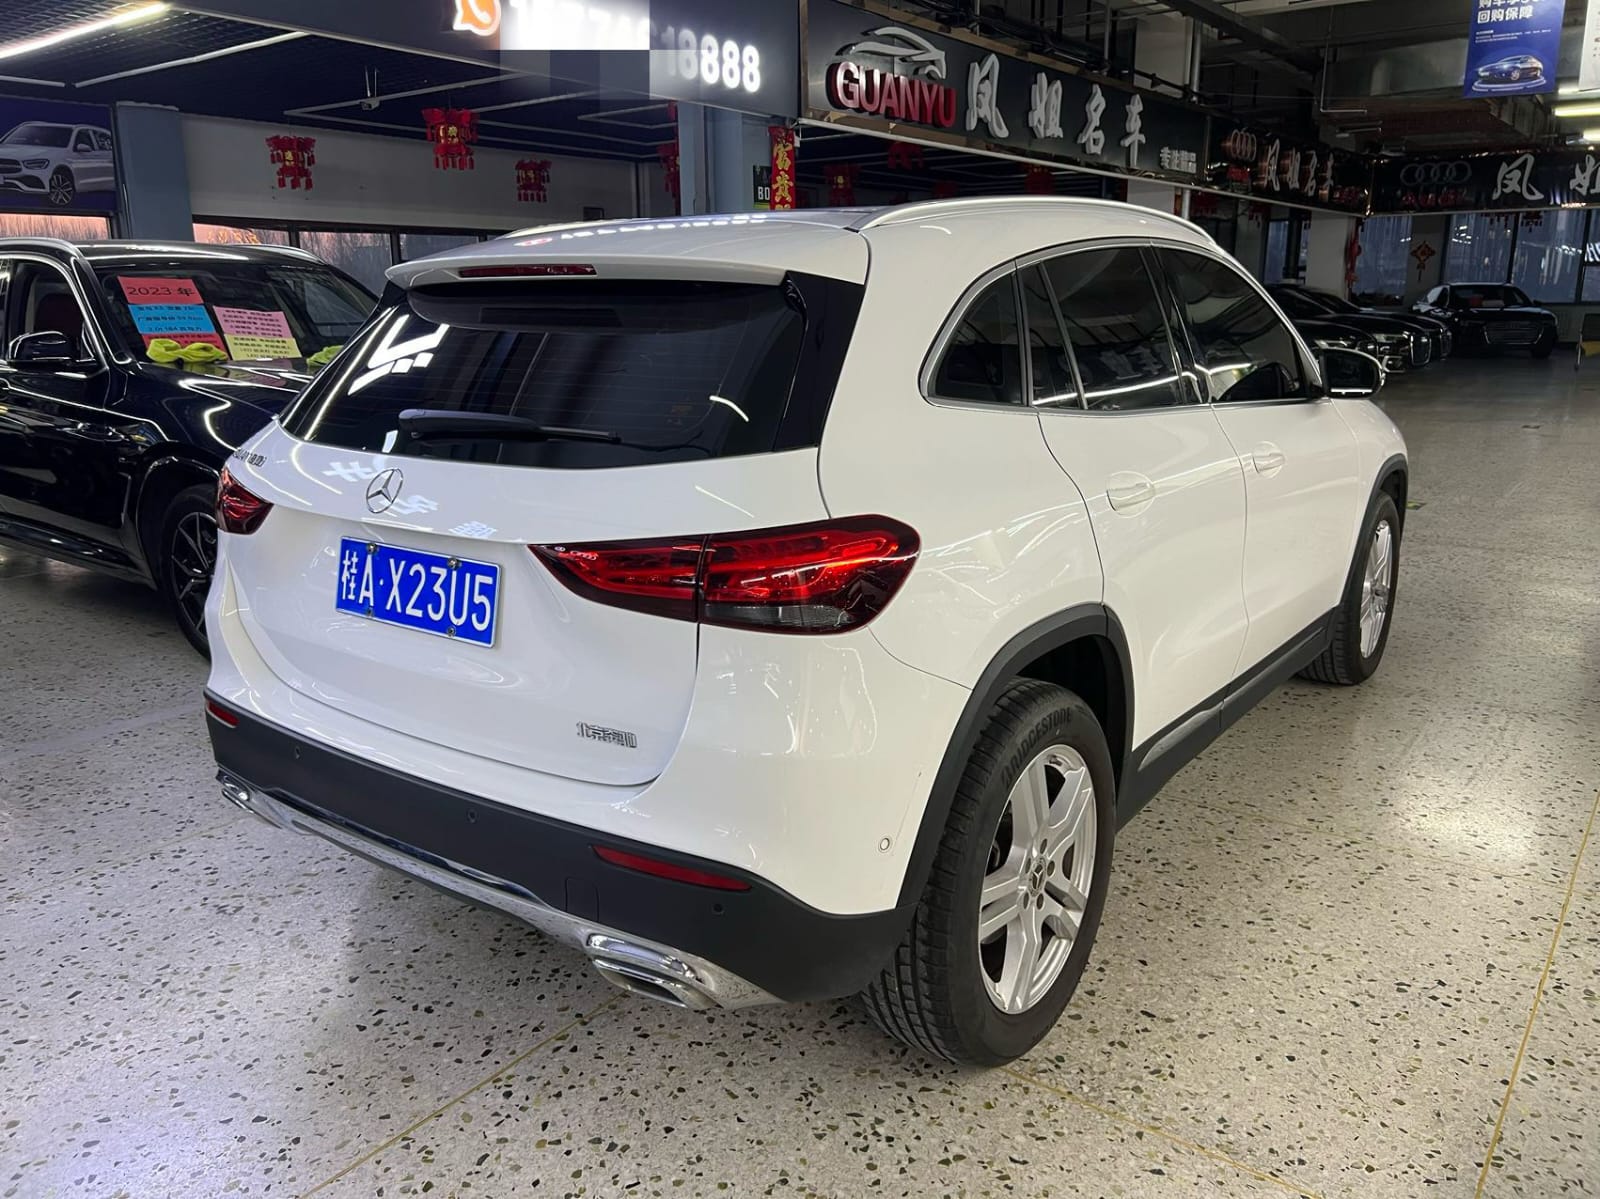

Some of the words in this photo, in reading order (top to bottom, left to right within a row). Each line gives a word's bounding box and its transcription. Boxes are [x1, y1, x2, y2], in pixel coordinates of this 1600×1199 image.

[1477, 5, 1533, 24] 回购保障
[832, 61, 957, 128] GUANYU
[965, 53, 1146, 168] 凤姐名车
[127, 286, 172, 296] 2023
[177, 287, 195, 296] 年
[1001, 706, 1071, 789] BRIDGESTONE
